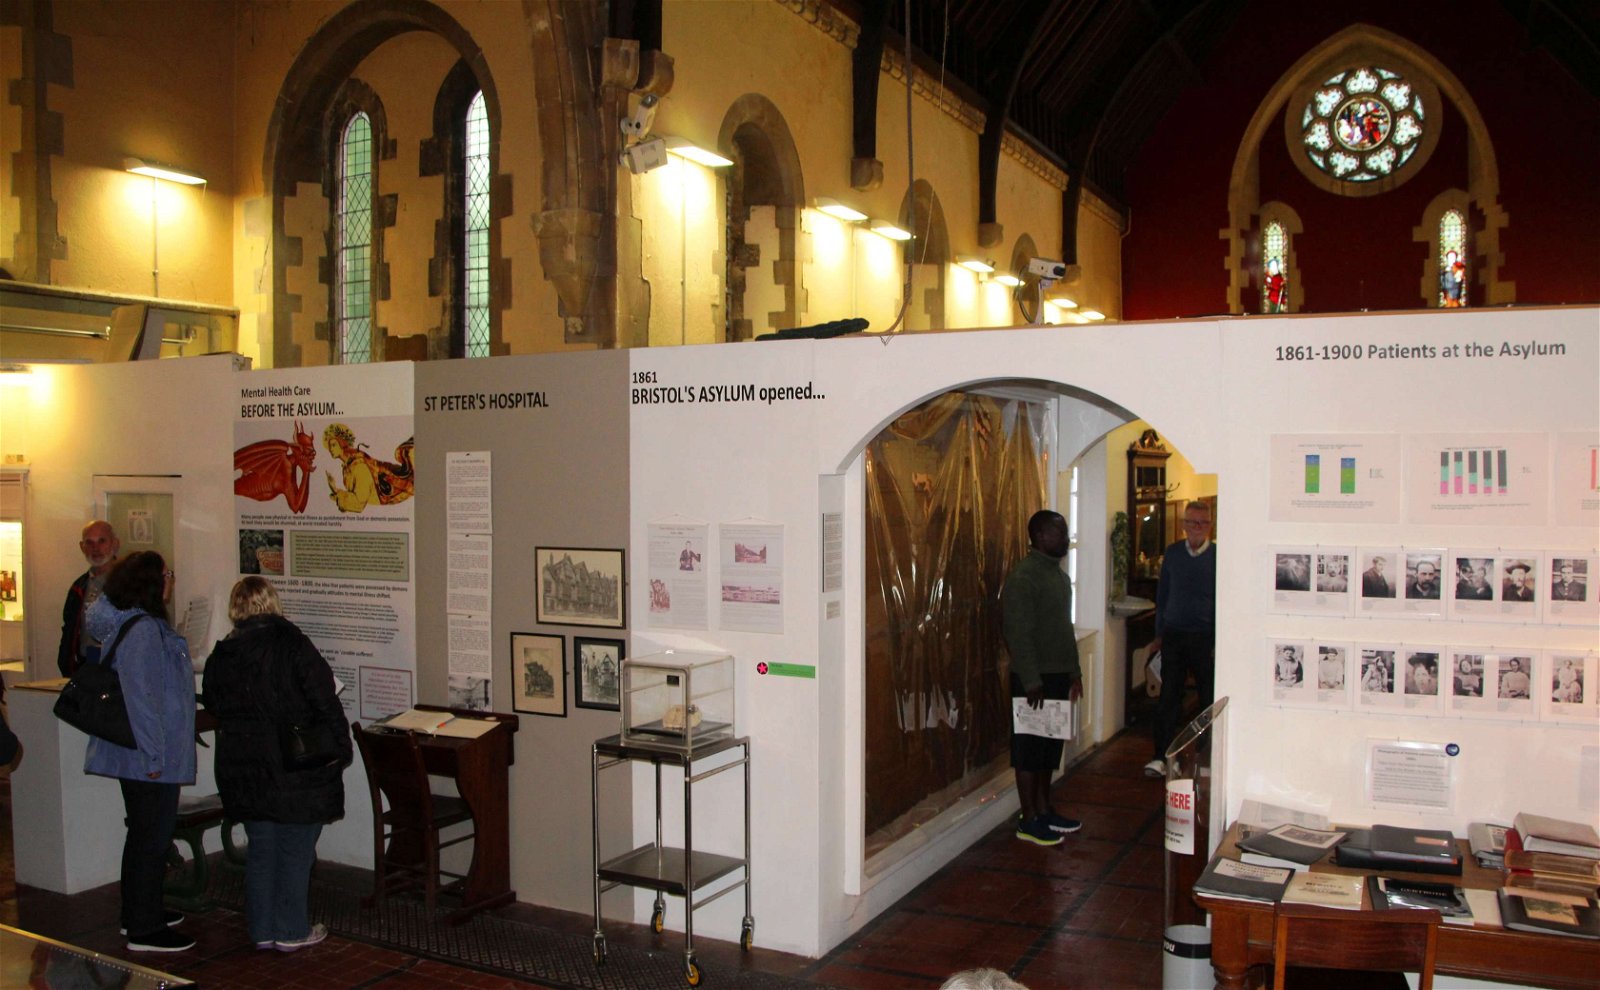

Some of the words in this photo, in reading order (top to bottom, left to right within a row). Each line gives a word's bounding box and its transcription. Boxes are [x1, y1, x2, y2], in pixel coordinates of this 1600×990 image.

[1275, 344, 1363, 361] 1861-1900
[1367, 342, 1436, 359] Patients
[1441, 343, 1459, 358] at
[1464, 341, 1494, 357] the
[1499, 339, 1567, 360] Asylum
[632, 371, 658, 384] 1861
[241, 386, 267, 398] Mental
[268, 386, 293, 397] Health
[293, 385, 311, 396] Care
[424, 396, 437, 411] ST
[440, 393, 486, 411] PETER'S
[489, 391, 549, 409] HOSPITAL
[632, 386, 695, 404] BRISTOL'S
[698, 384, 755, 402] ASYLUM
[759, 381, 826, 405] opened...
[241, 403, 275, 418] BEFORE
[277, 403, 295, 417] THE
[296, 402, 344, 416] ASYLUM...
[1170, 791, 1191, 811] HERE
